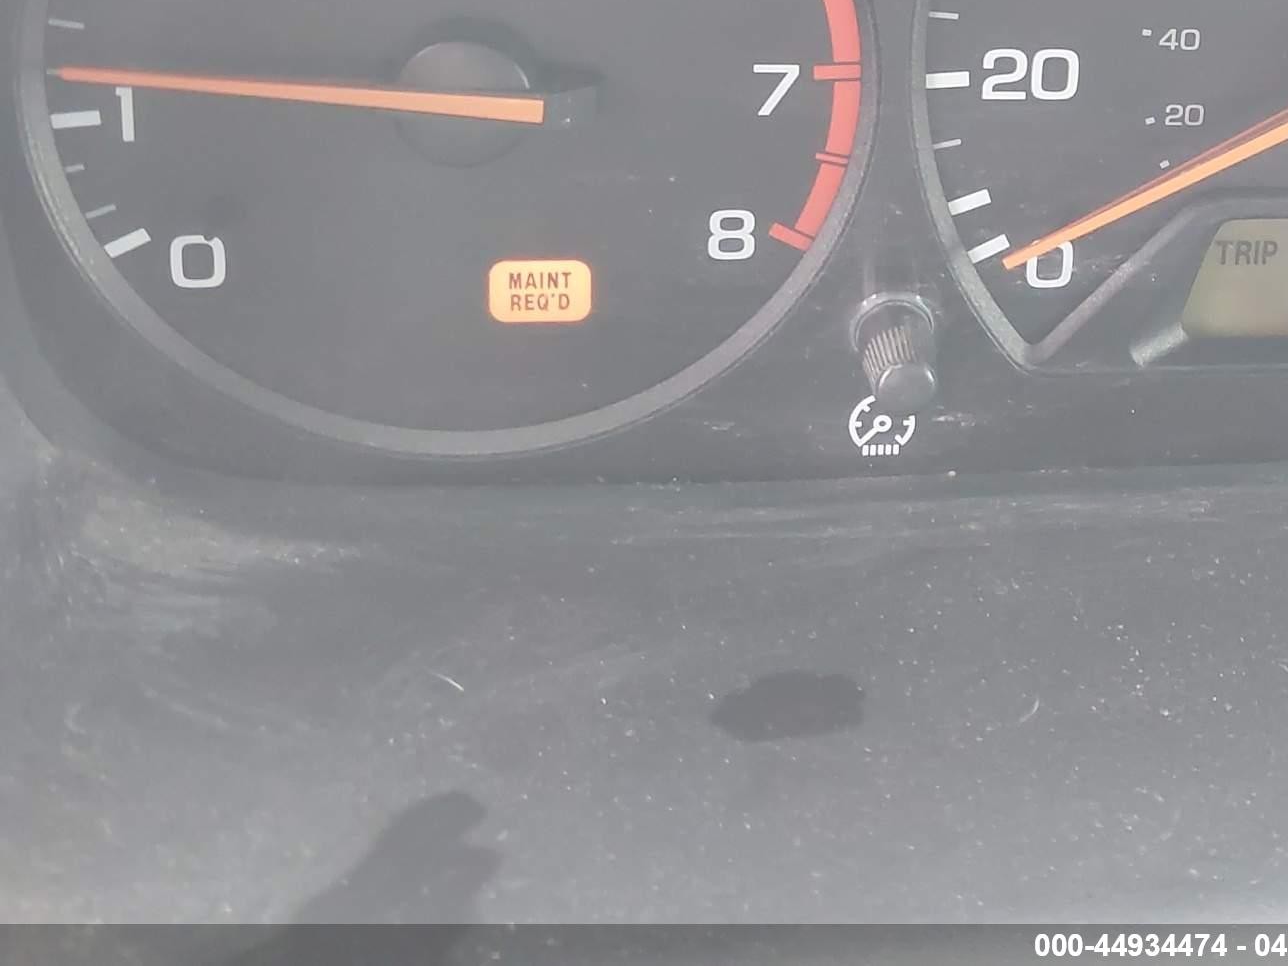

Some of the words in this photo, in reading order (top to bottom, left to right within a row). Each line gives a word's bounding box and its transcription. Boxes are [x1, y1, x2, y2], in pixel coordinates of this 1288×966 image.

[1158, 28, 1200, 51] 40
[752, 64, 800, 117] 7
[981, 48, 1080, 100] 20
[115, 87, 134, 141] 1
[1164, 104, 1204, 126] 20
[707, 209, 756, 260] 8
[1217, 240, 1278, 265] TRIP
[170, 235, 227, 289] 0
[508, 271, 572, 292] MAINT
[1026, 240, 1074, 289] 0
[510, 293, 571, 313] REQ'D
